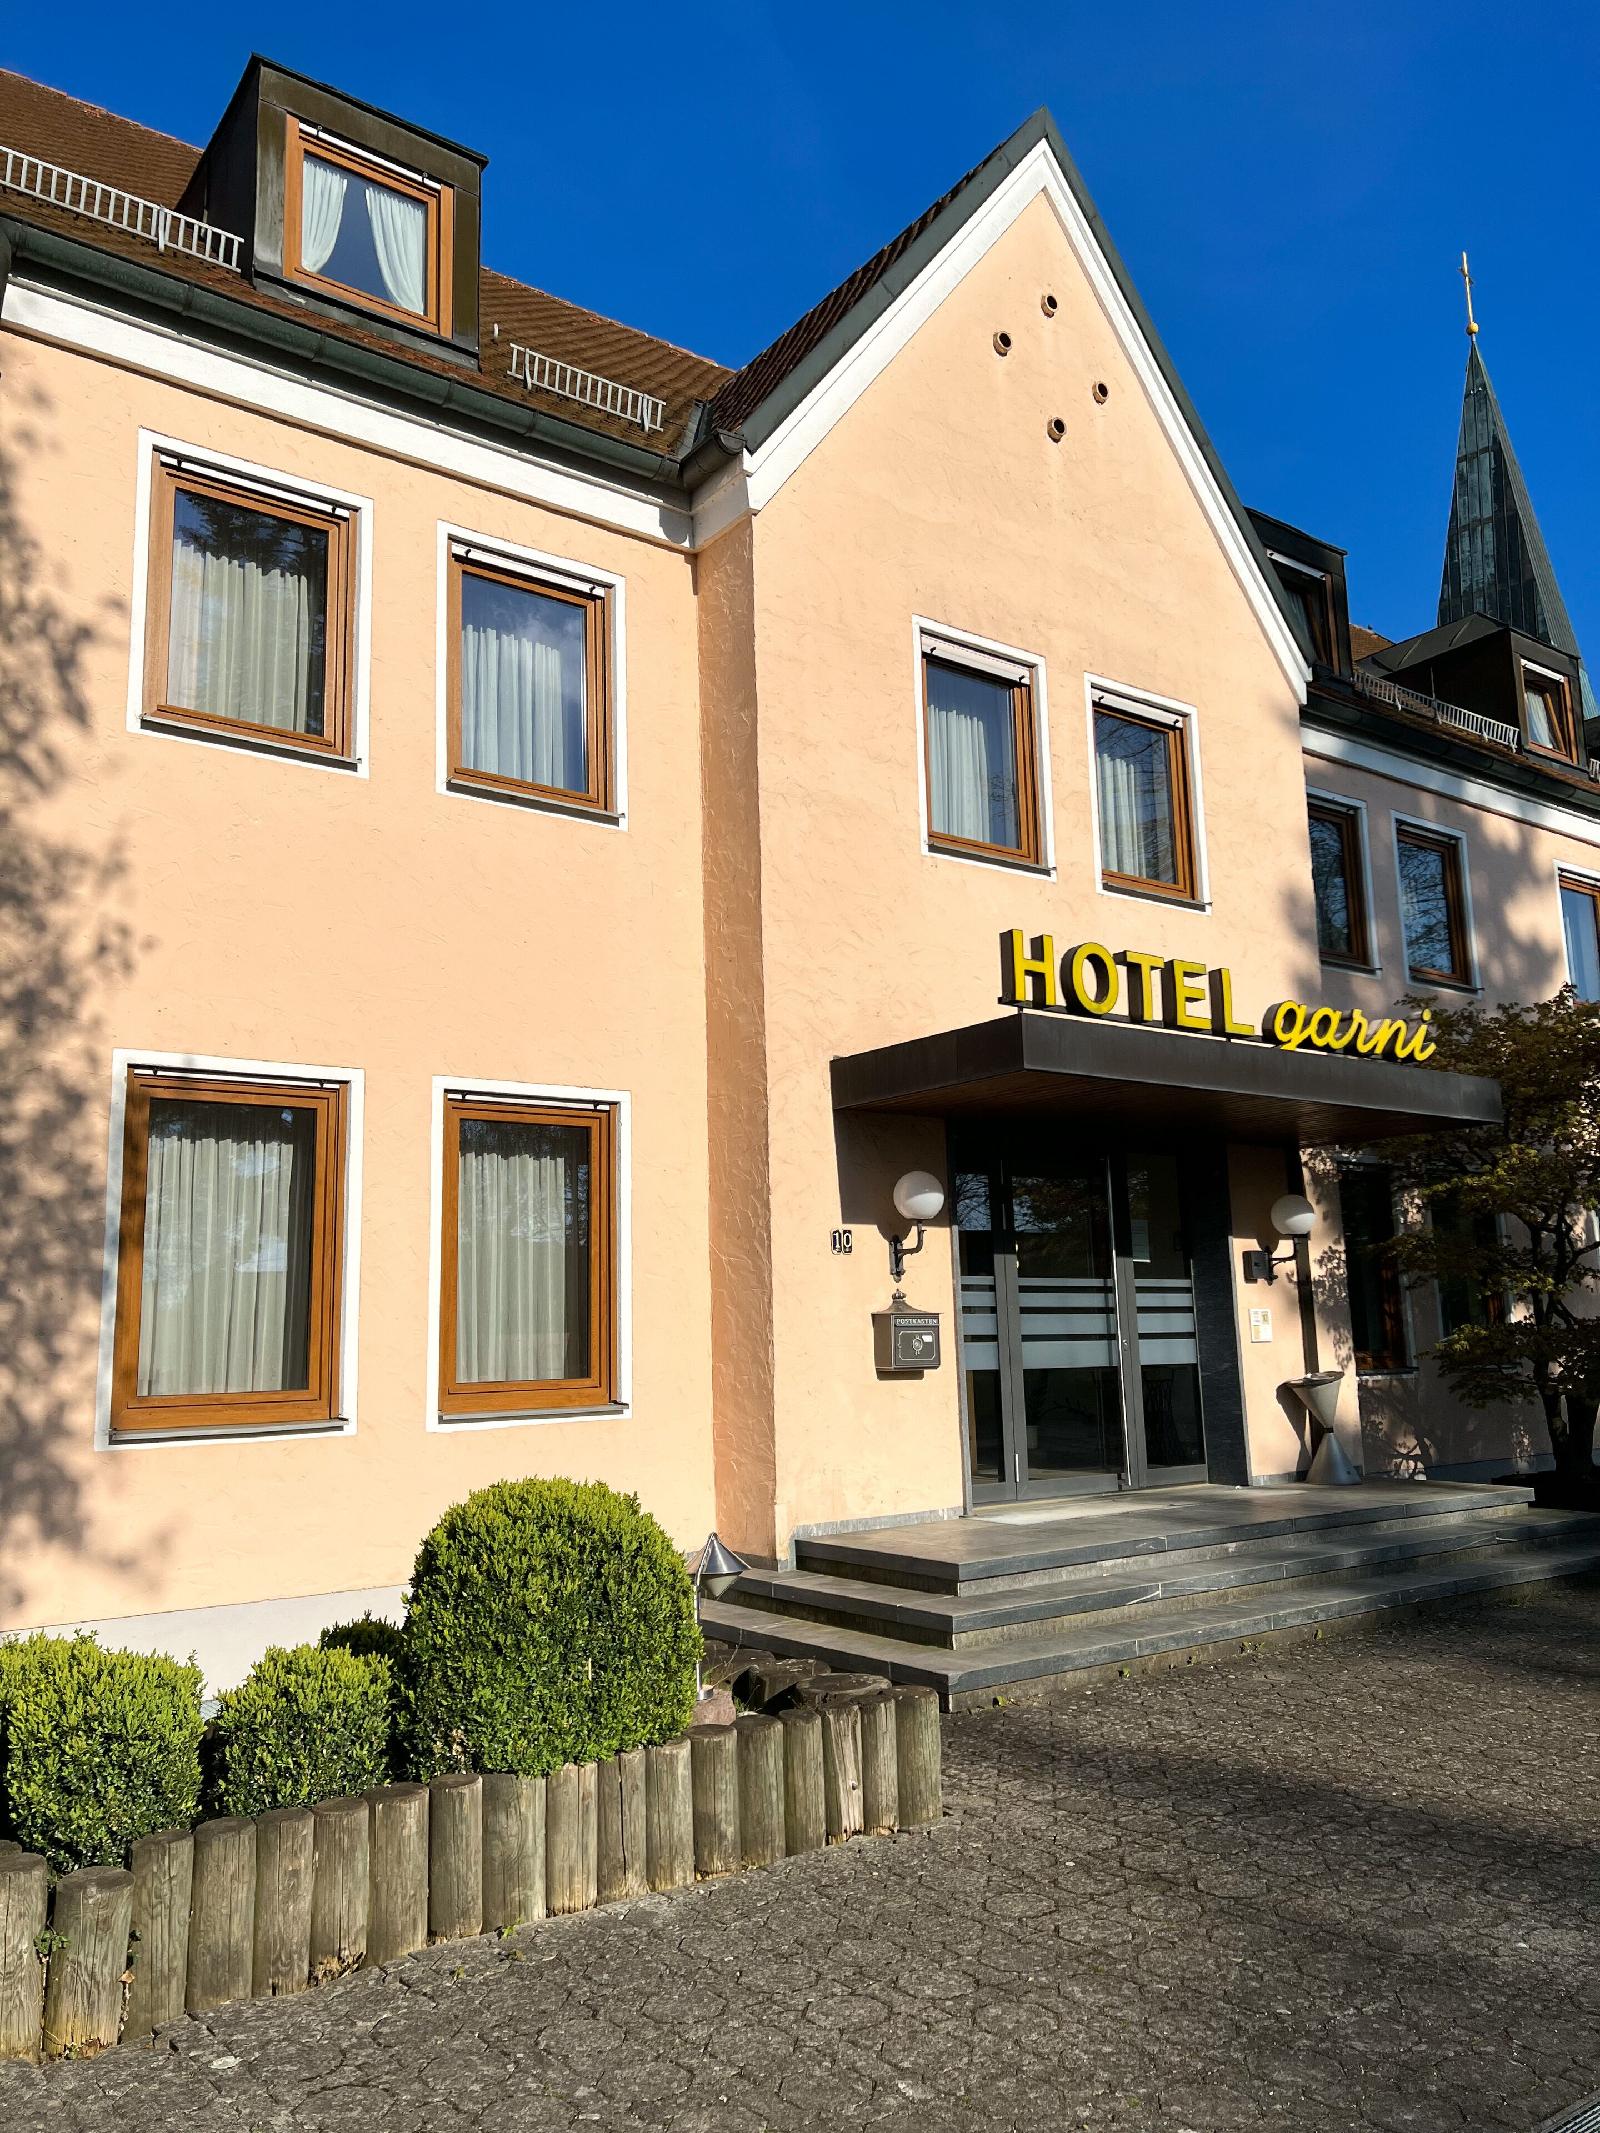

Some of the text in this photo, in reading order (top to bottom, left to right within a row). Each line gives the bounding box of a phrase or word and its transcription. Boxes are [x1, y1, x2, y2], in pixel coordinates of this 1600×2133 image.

[1000, 928, 1437, 1062] HOTEL garni
[832, 1231, 852, 1250] 10
